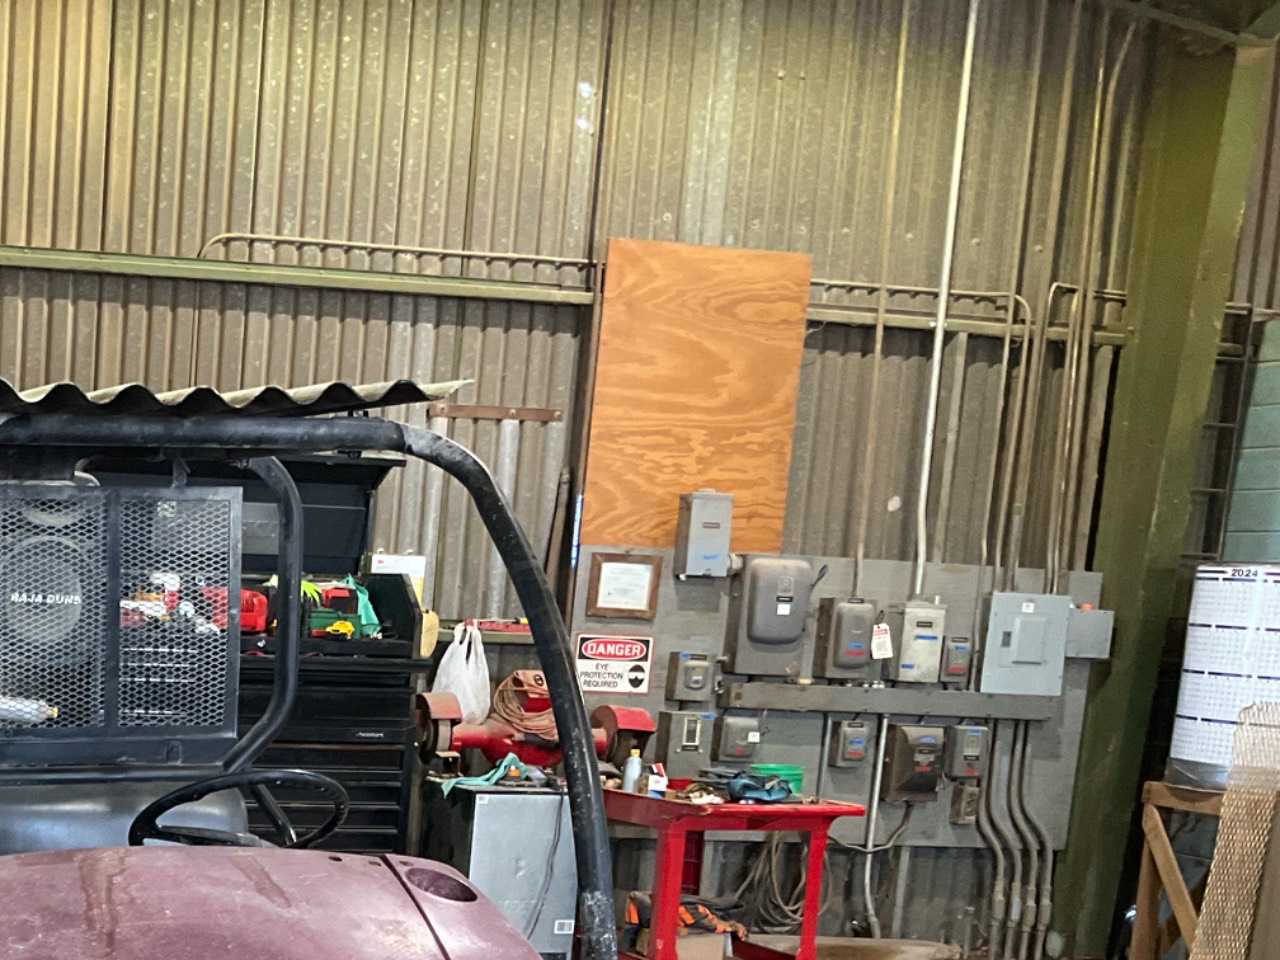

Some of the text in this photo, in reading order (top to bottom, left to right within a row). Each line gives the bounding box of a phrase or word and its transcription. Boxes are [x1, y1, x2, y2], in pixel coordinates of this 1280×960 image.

[1231, 568, 1258, 577] 2024
[587, 642, 641, 657] DANGER
[595, 663, 609, 671] EYE
[580, 671, 624, 680] PROTECTION
[583, 680, 619, 688] REQUIRED
